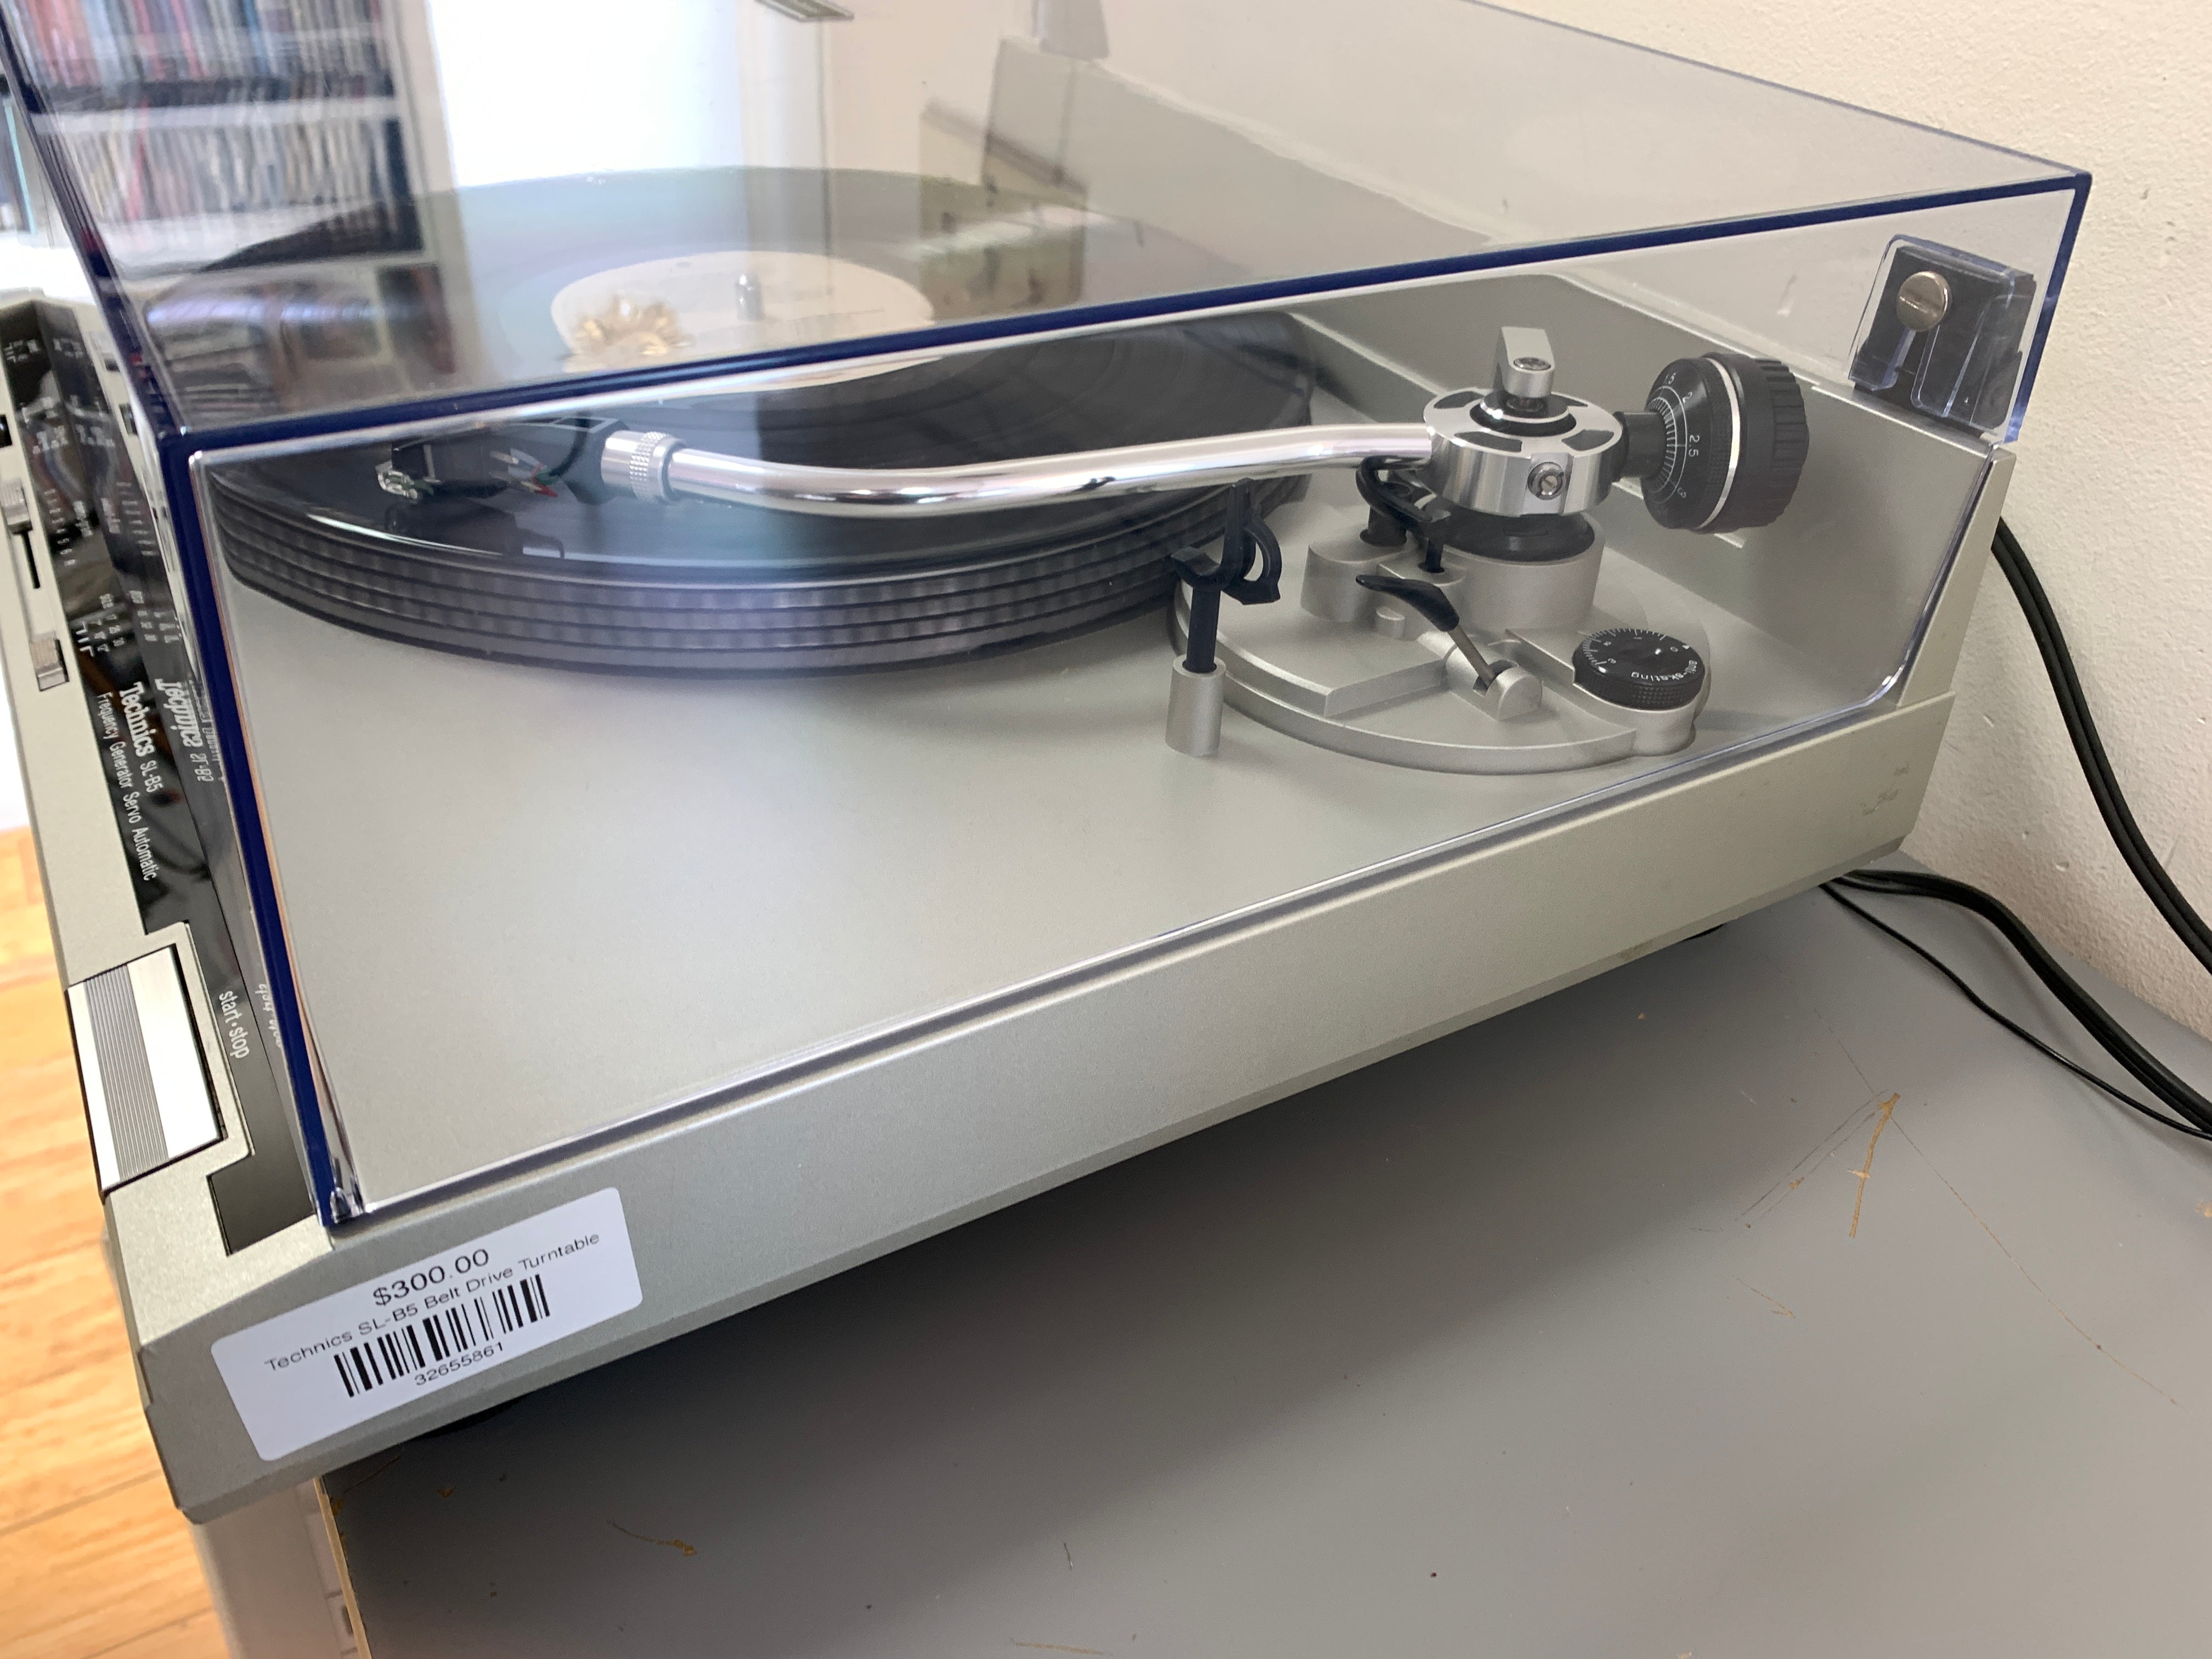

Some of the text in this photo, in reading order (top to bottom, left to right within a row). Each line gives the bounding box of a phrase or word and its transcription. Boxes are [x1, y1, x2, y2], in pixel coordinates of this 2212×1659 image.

[1683, 392, 1692, 403] 2
[1689, 435, 1700, 458] 2.5
[1678, 487, 1686, 498] 3
[119, 681, 163, 793] Technics SL-B5
[97, 692, 159, 881] Frequency Generator Servo Automatic
[264, 1231, 601, 1372] Technics SL-B5 Belt Drive Turntable
[373, 1248, 489, 1307] $300.00
[414, 1341, 505, 1386] 32655861
